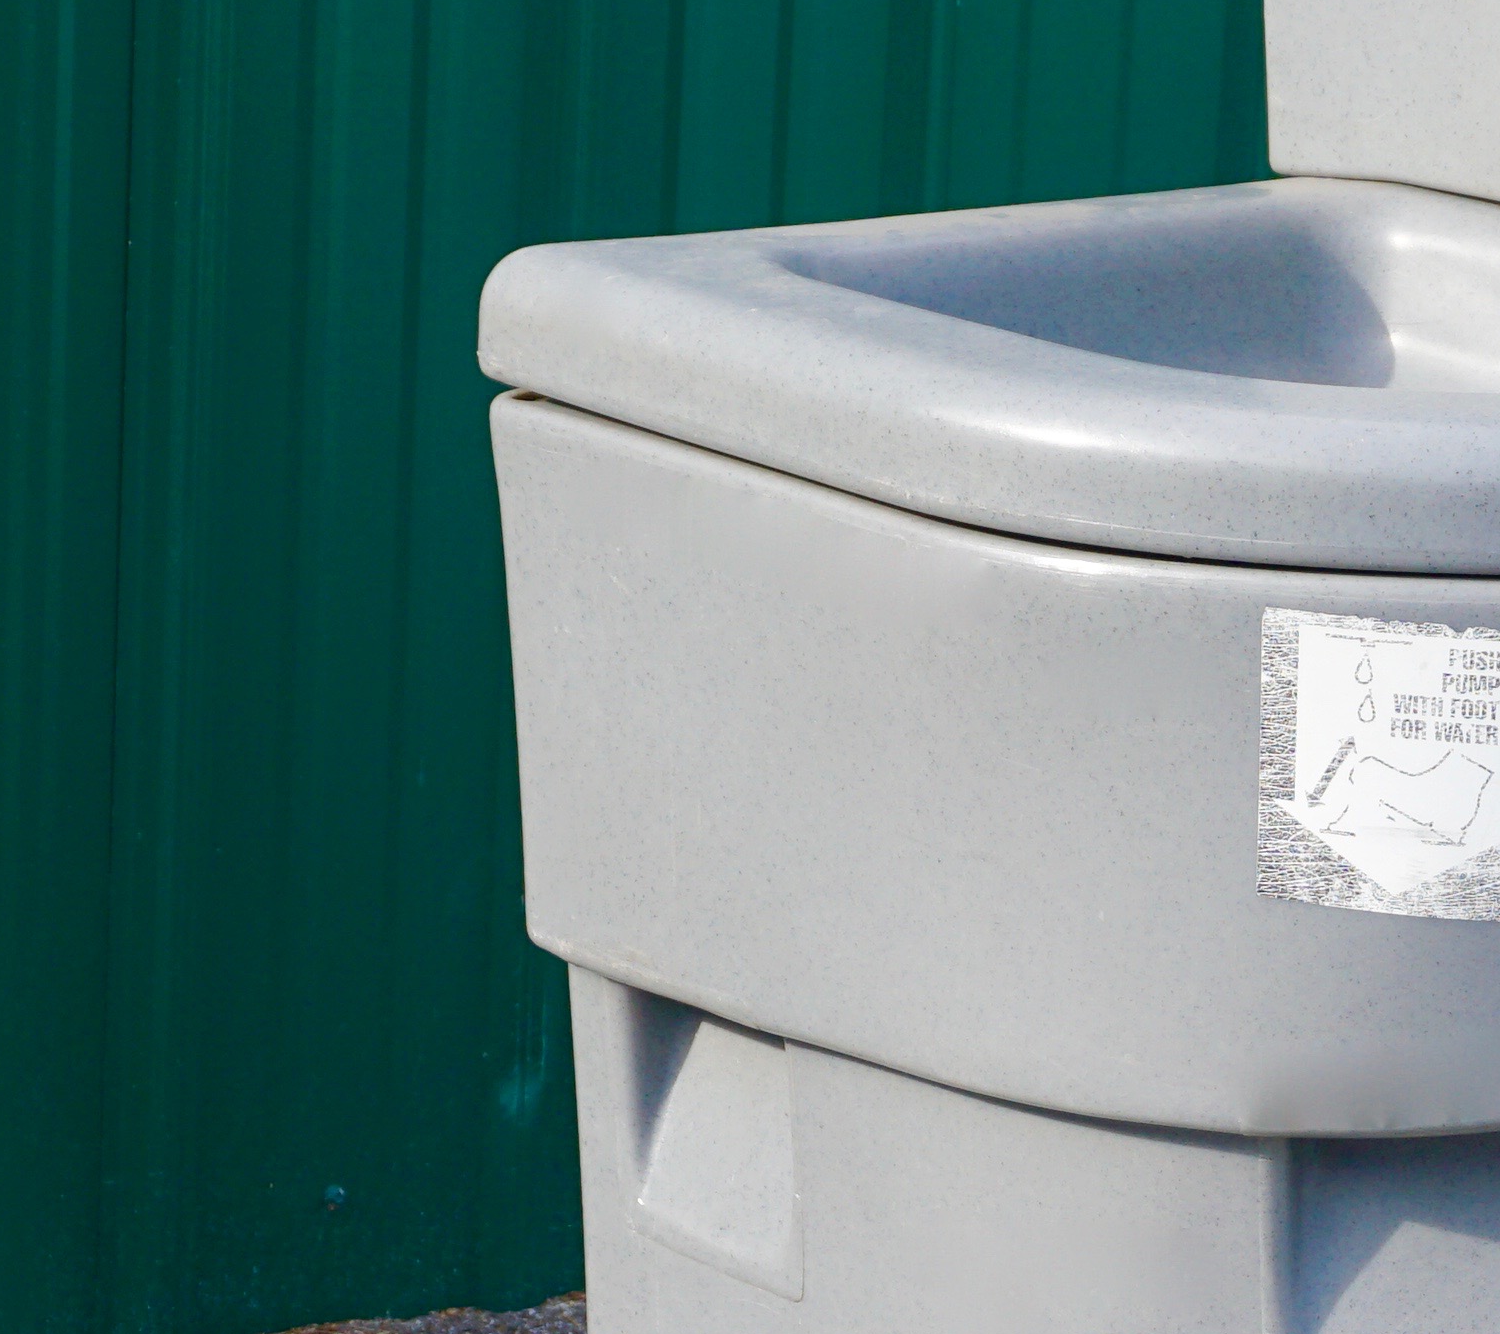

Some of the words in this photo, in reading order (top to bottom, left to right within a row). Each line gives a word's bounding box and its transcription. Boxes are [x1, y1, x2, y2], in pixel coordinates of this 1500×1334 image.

[1442, 672, 1500, 695] PUMP
[1393, 693, 1444, 717] WITH
[1450, 698, 1500, 720] FOOT
[1390, 717, 1427, 740] FOR
[1434, 721, 1499, 745] WATER
